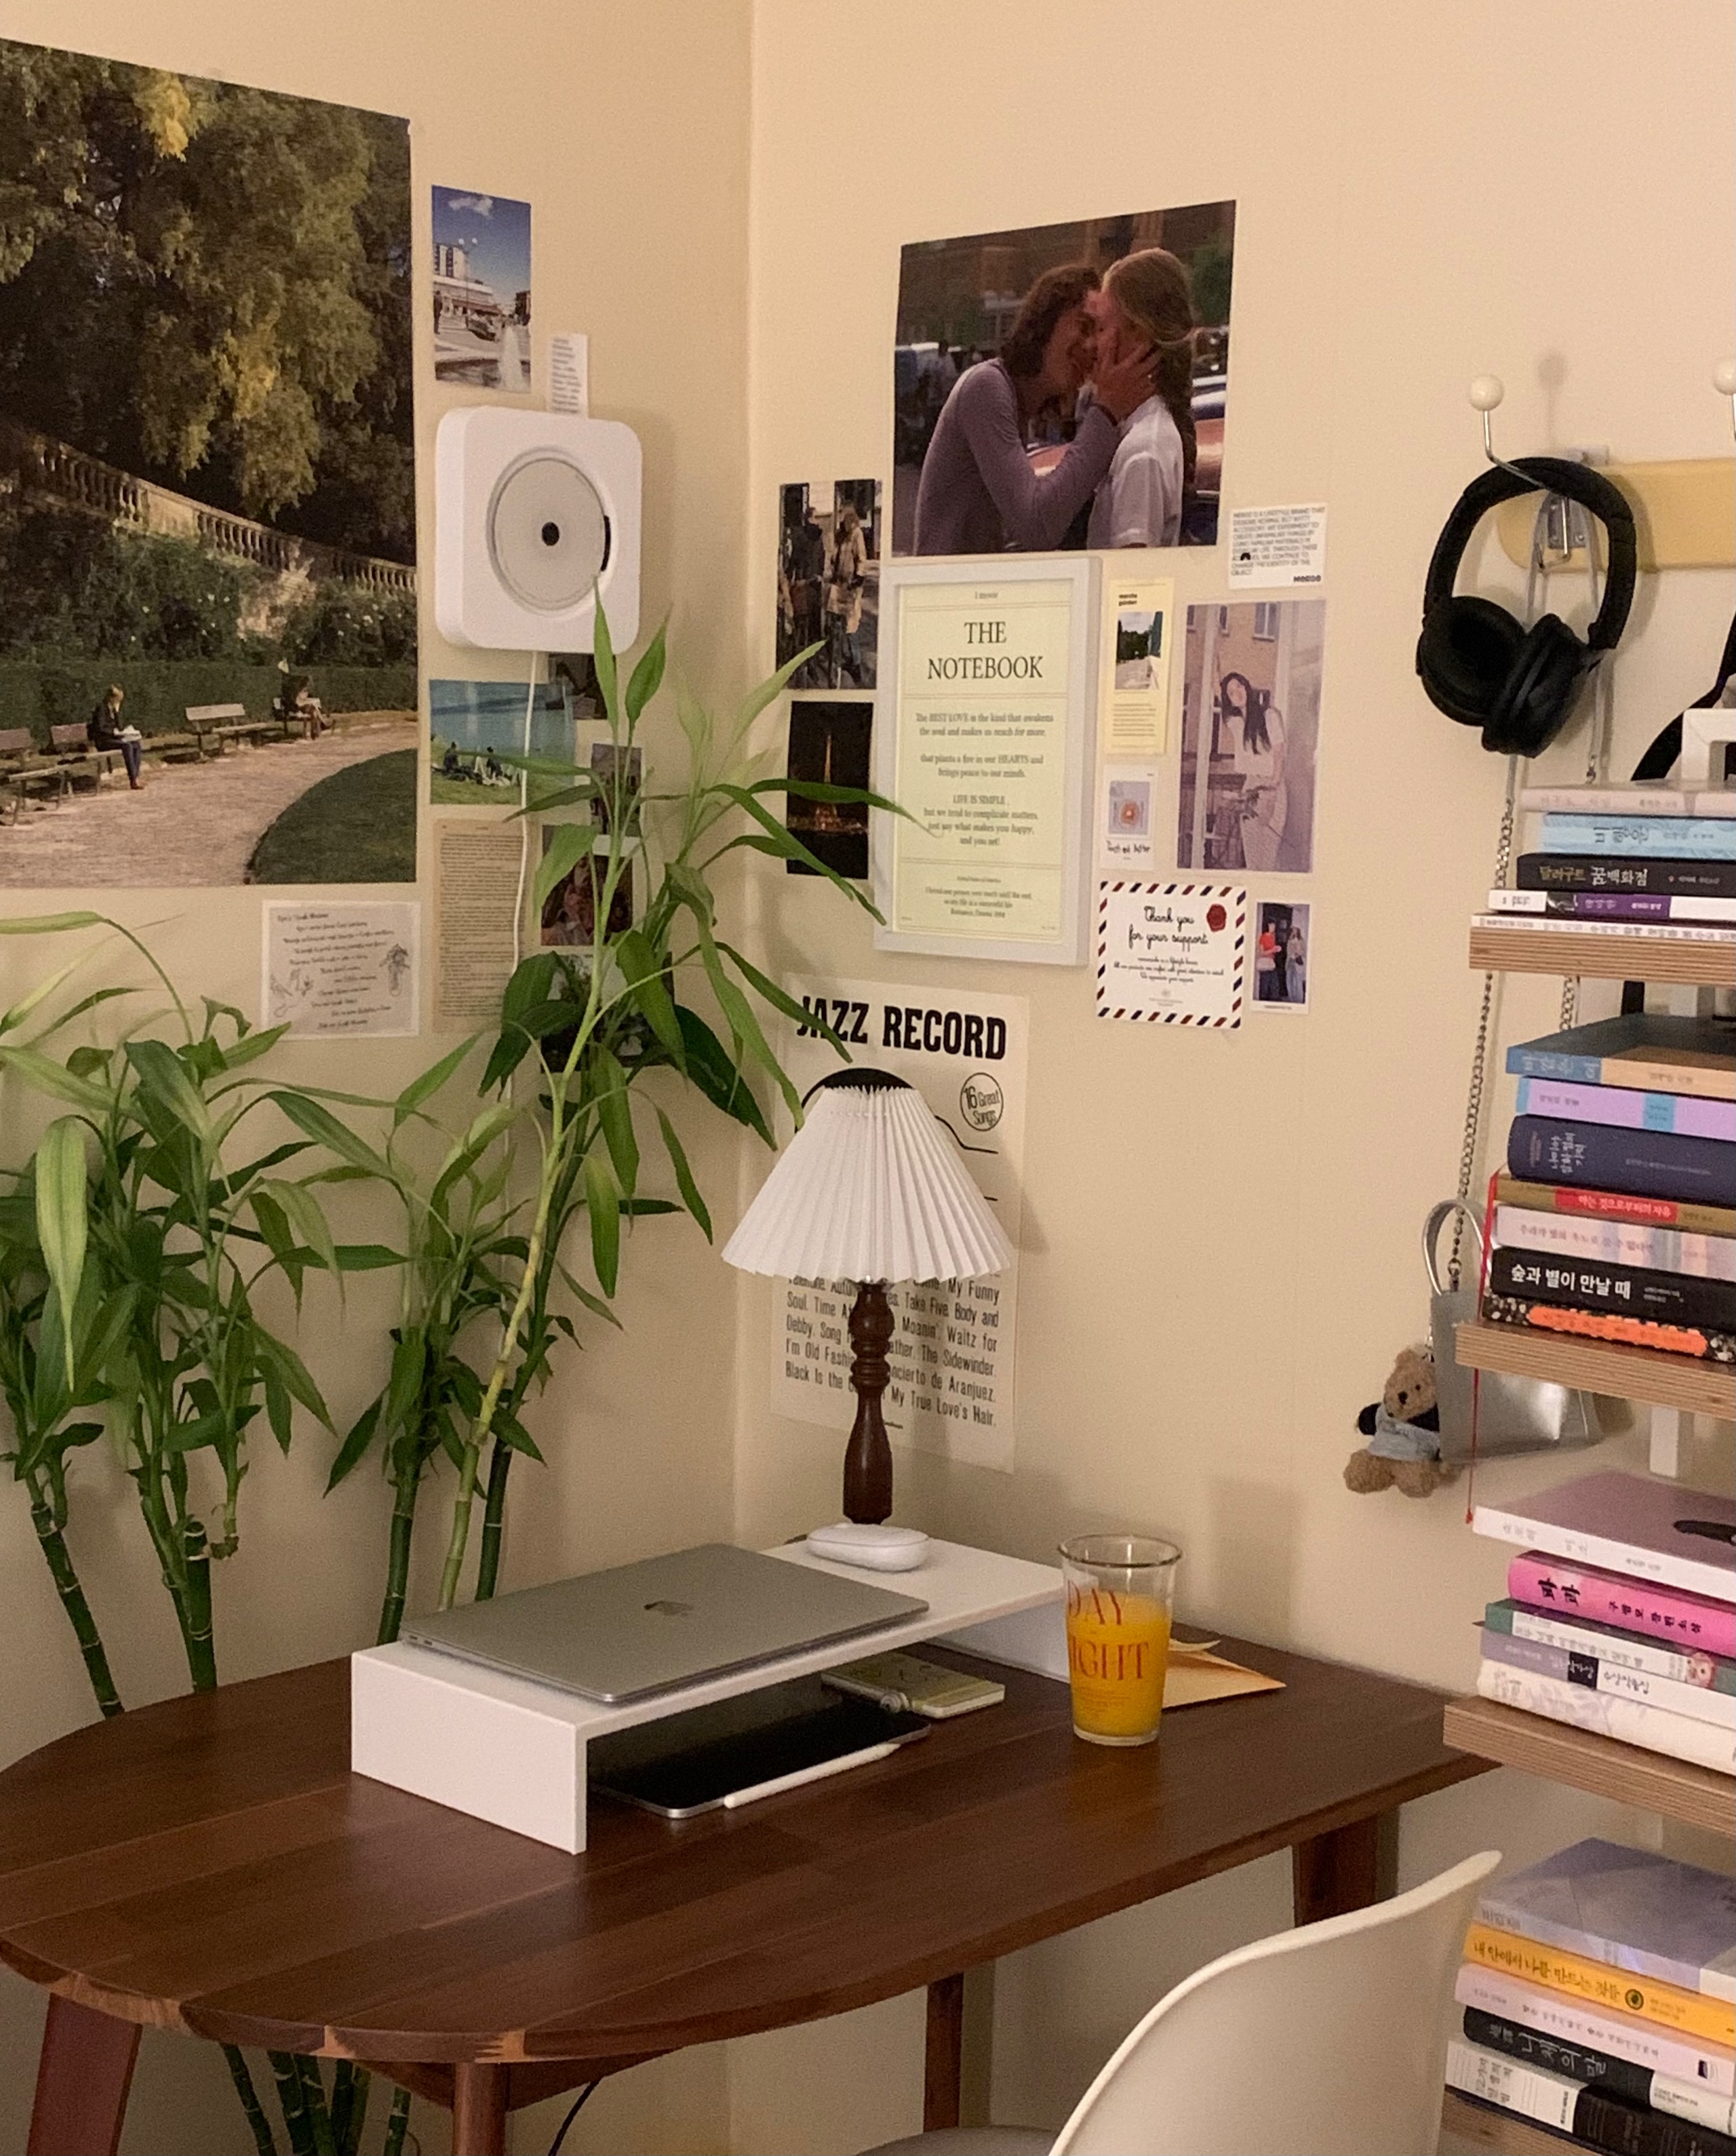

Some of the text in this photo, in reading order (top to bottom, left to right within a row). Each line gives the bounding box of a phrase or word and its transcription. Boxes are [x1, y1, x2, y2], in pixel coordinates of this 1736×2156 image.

[964, 621, 1007, 644] THE
[928, 656, 1043, 680] NOTEBOOK
[1144, 905, 1195, 933] Thank you
[1128, 924, 1143, 949] for
[1147, 933, 1168, 949] your
[797, 996, 1006, 1060] JAZZ RECORD
[963, 1086, 977, 1110] 16
[968, 1280, 1000, 1306] Funny
[1512, 1263, 1541, 1285] 숲과
[1545, 1268, 1576, 1291] 별이
[1580, 1275, 1611, 1296] 만날
[1615, 1280, 1631, 1299] 때
[814, 1296, 835, 1316] Time
[947, 1326, 976, 1348] Waltz
[983, 1333, 998, 1352] for
[906, 1292, 926, 1312] Take
[955, 1302, 977, 1326] Body
[982, 1310, 999, 1327] and
[821, 1322, 842, 1345] Song
[922, 1344, 938, 1364] The
[806, 1341, 819, 1360] Old
[931, 1371, 943, 1390] de
[786, 1360, 809, 1381] Black
[829, 1371, 843, 1389] the
[891, 1386, 905, 1407] My
[911, 1390, 932, 1411] True
[936, 1396, 968, 1420] Love's
[1538, 1577, 1581, 1606] 파과
[1474, 1941, 1485, 1957] 내
